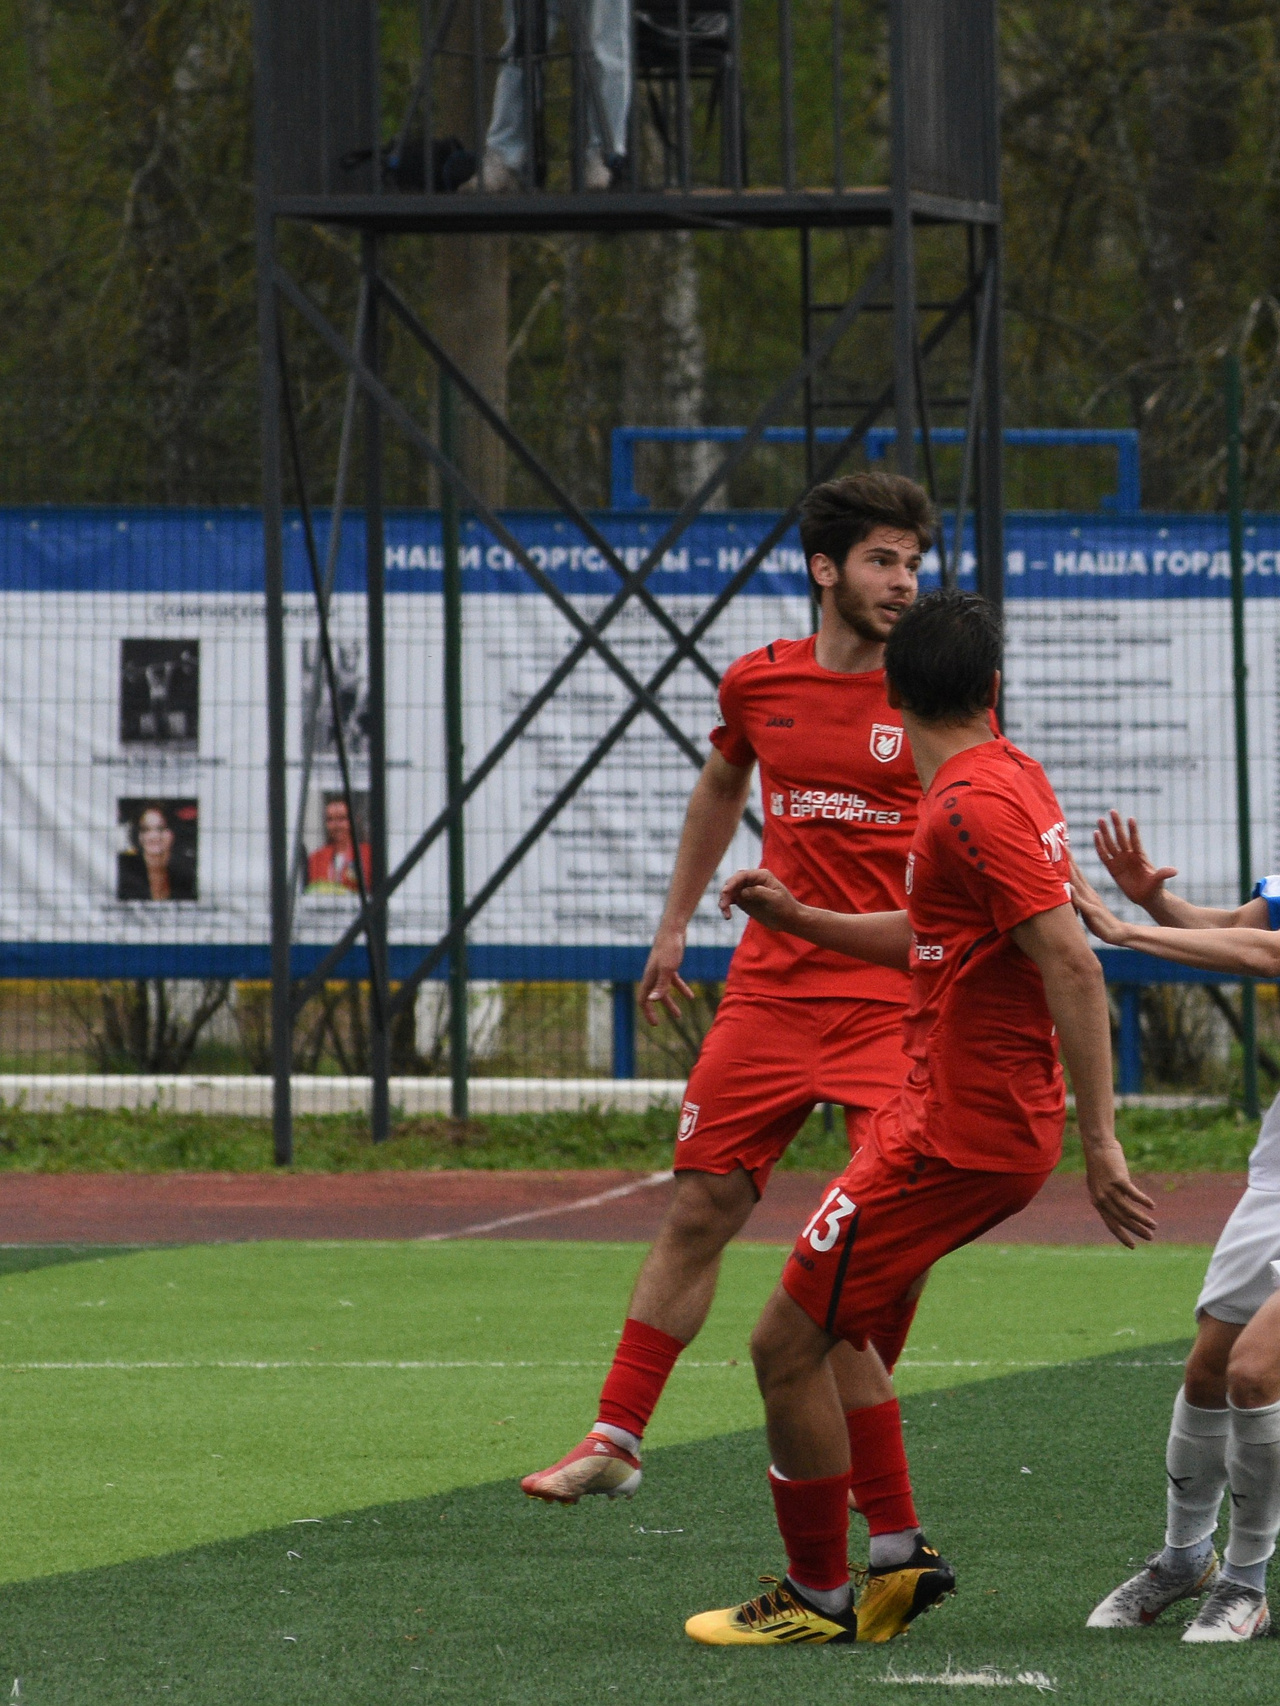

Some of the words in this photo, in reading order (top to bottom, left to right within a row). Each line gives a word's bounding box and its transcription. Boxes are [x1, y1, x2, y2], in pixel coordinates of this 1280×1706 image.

[1054, 550, 1148, 575] НАША
[789, 789, 867, 809] КАЗАНЬ
[789, 803, 902, 825] ОРГСИНТЕЗ
[801, 1186, 857, 1253] 13
